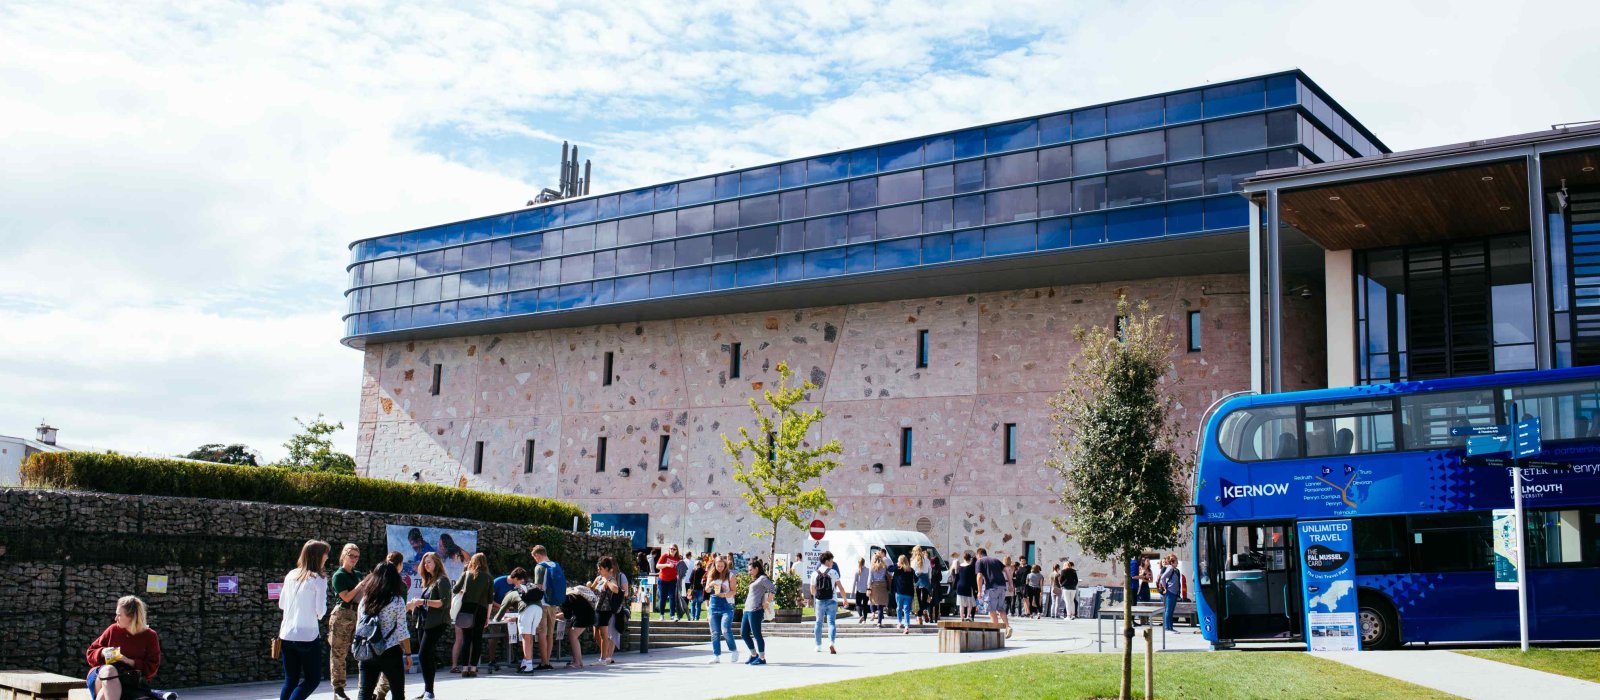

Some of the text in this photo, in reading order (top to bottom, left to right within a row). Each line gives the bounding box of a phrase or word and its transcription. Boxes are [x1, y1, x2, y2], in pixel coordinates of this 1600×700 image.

[1223, 482, 1290, 499] KERNOW
[1510, 484, 1563, 494] FLMOUTH
[592, 520, 605, 528] The
[1302, 523, 1348, 533] UNLIMITED
[1309, 533, 1343, 542] TRAVEL
[1318, 553, 1343, 561] MUSSEL
